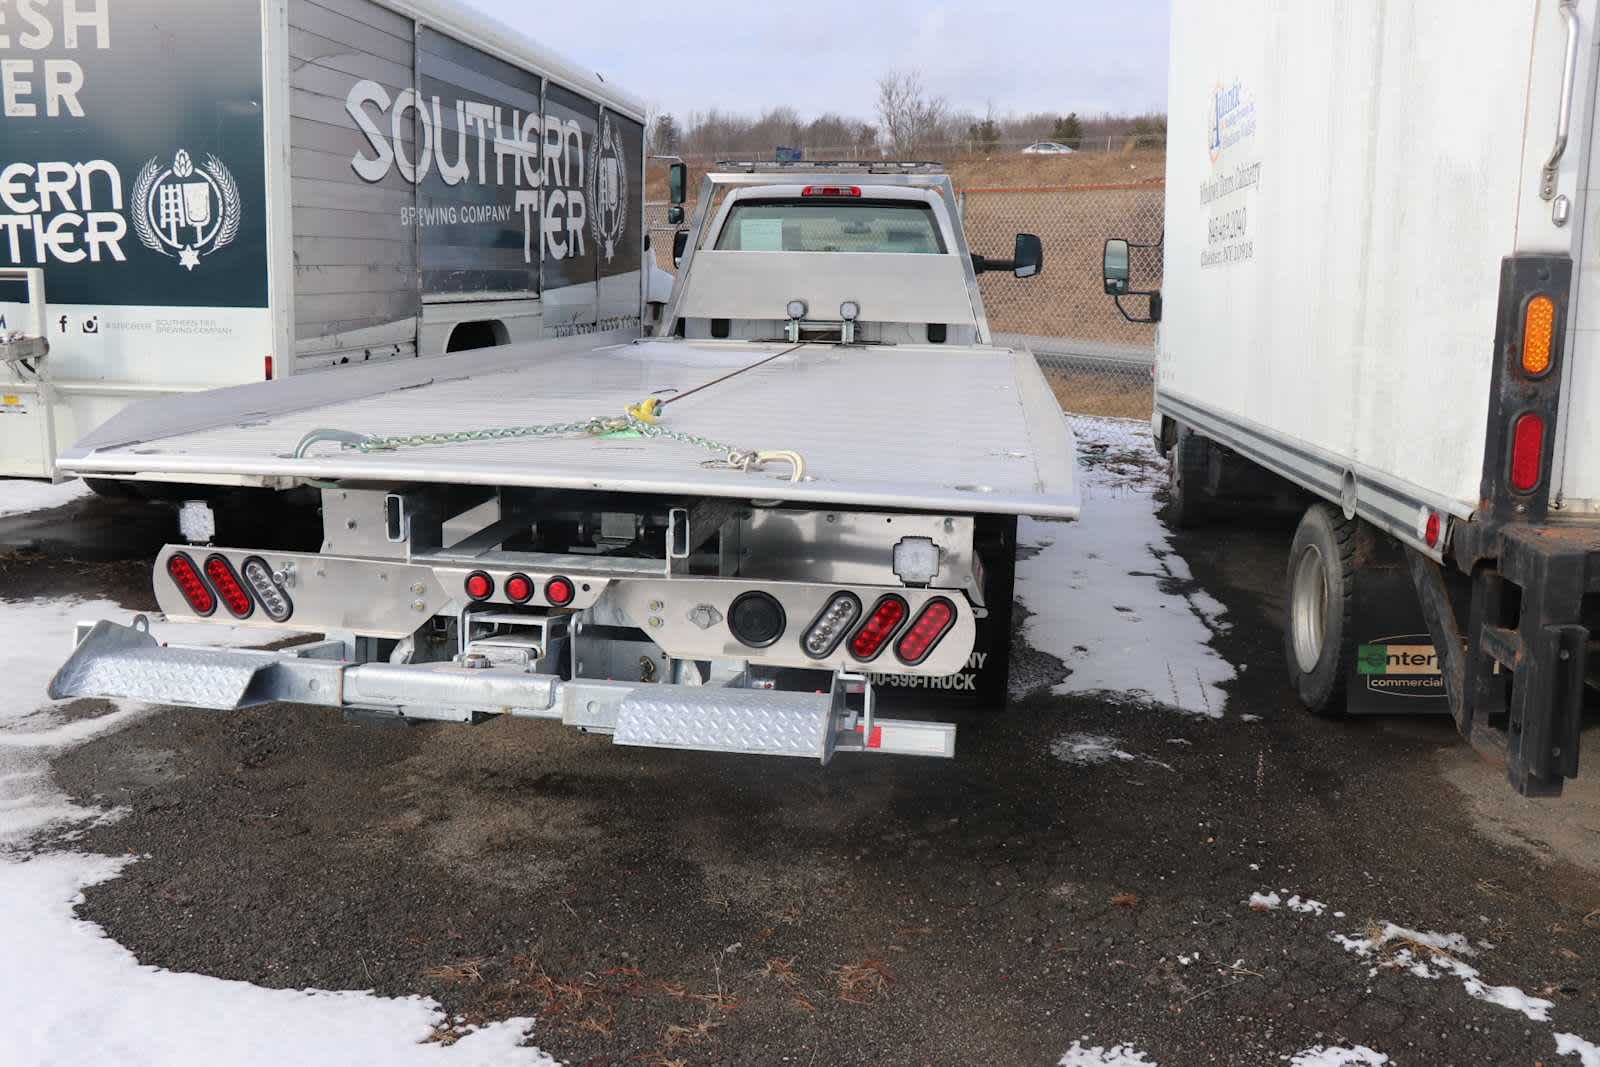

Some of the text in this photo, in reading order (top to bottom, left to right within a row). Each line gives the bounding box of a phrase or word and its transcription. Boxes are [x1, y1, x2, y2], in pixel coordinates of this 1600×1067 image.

[345, 79, 584, 186] SOUTHERN
[400, 205, 512, 227] BREWING COMPANY
[515, 190, 586, 264] TIER
[0, 212, 127, 264] TIER
[1366, 652, 1441, 670] enter
[862, 672, 976, 691] 00-598-TRUCK
[1371, 678, 1443, 688] commercial
